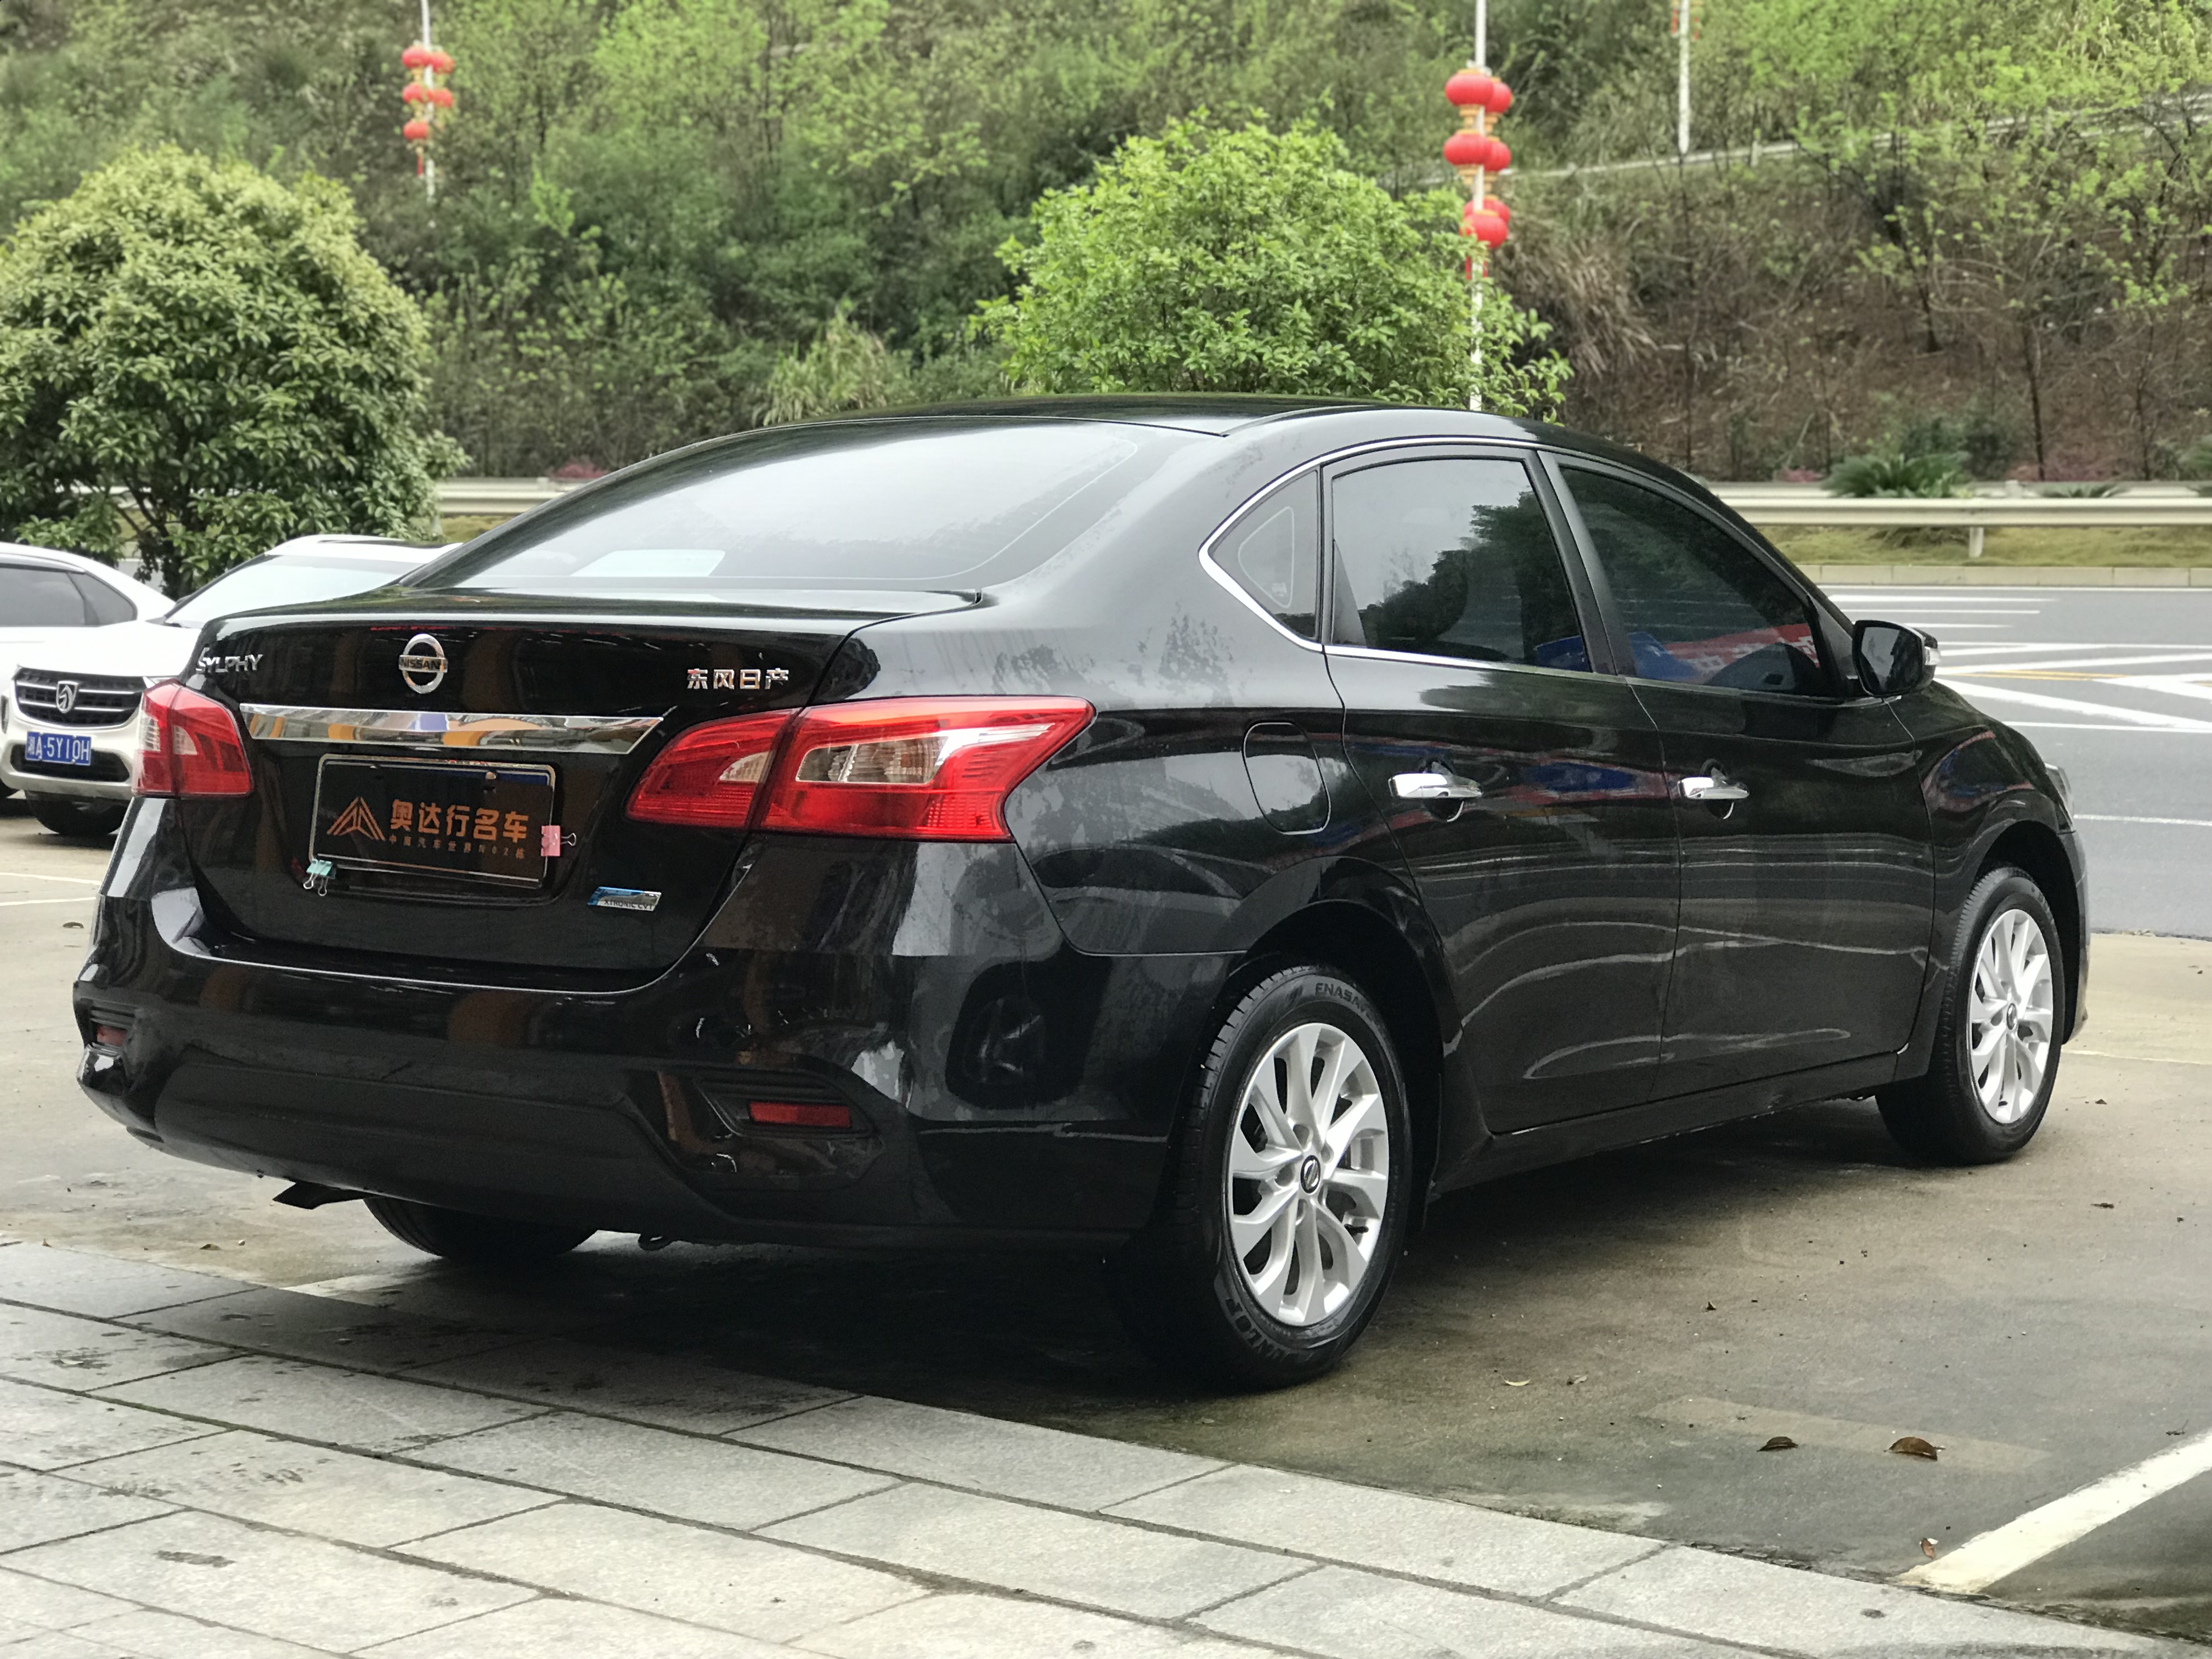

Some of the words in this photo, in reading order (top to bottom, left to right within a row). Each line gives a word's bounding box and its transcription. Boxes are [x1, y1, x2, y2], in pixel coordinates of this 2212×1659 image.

[195, 647, 264, 673] SYLPHY
[400, 658, 441, 669] NISSAN
[687, 667, 789, 690] 东风日产
[390, 798, 529, 843] 奥达行名车
